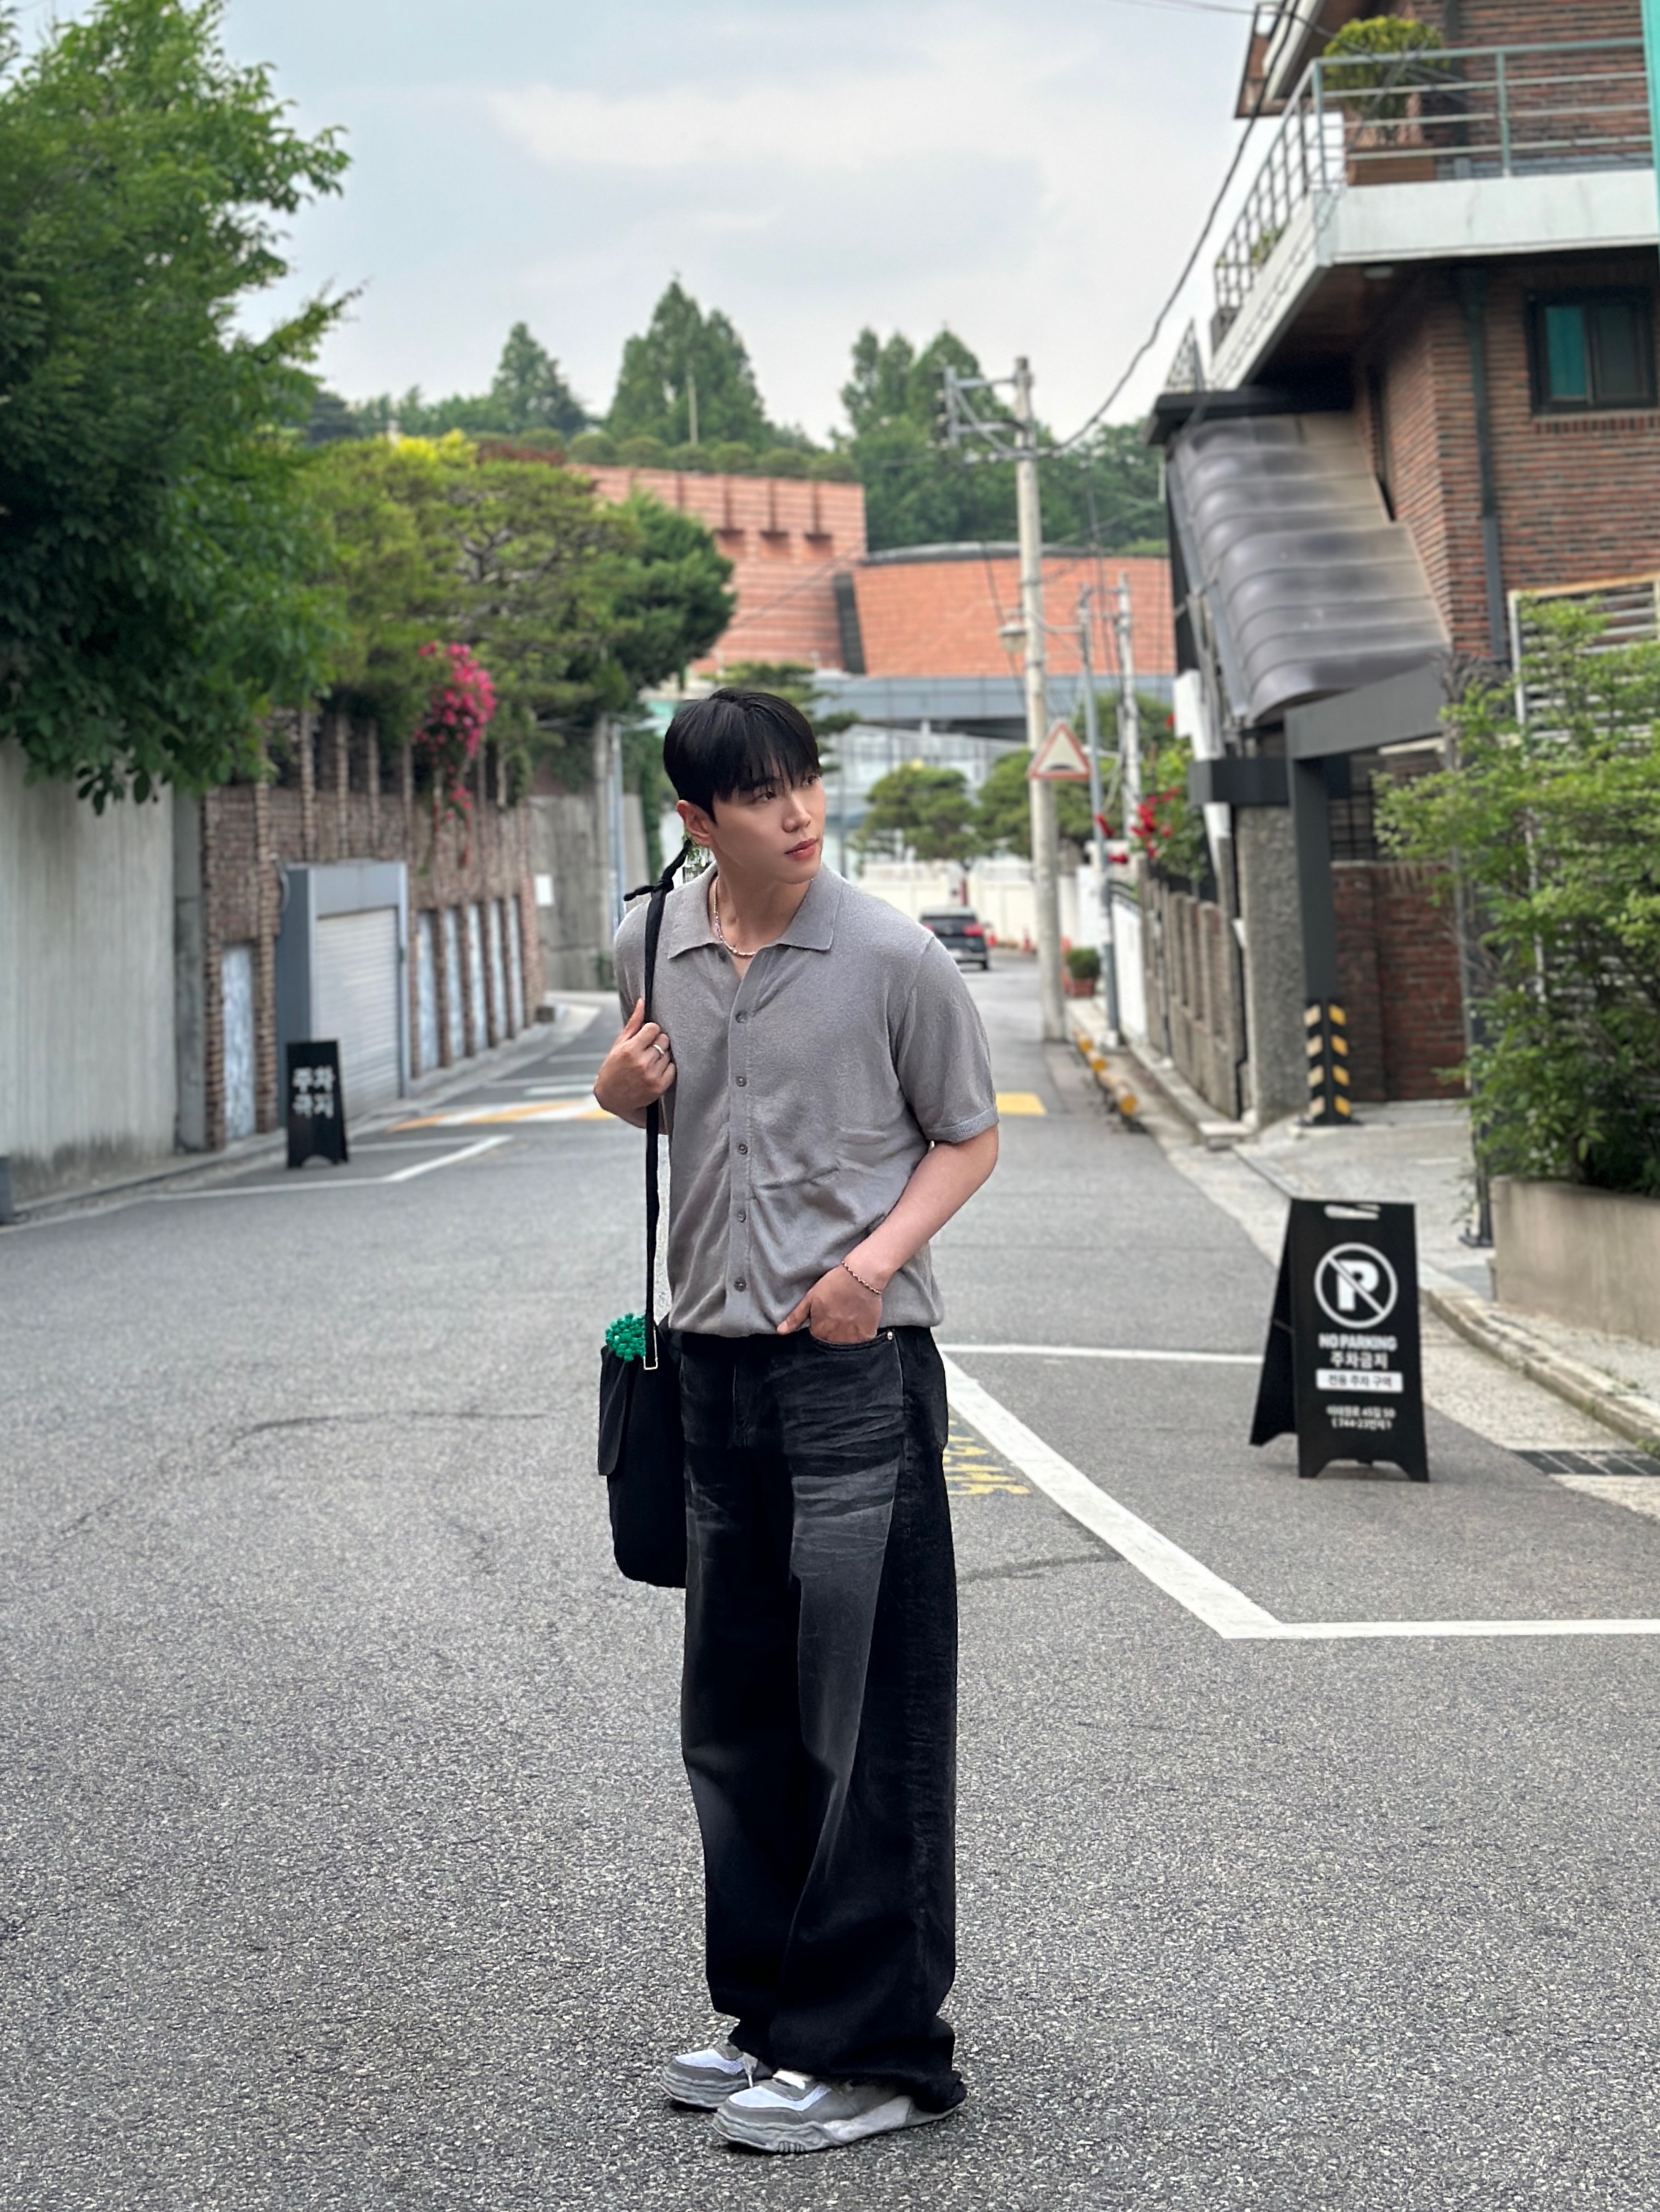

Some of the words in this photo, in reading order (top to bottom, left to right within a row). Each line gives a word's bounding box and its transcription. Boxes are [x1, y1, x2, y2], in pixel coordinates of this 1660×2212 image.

[293, 1066, 336, 1093] 주차
[1318, 1333, 1338, 1349] NO
[1339, 1334, 1397, 1352] PARKING
[1330, 1350, 1389, 1370] 주차금지
[1328, 1374, 1347, 1386] 전용
[1350, 1375, 1369, 1387] 주차
[1372, 1376, 1392, 1388] 구역
